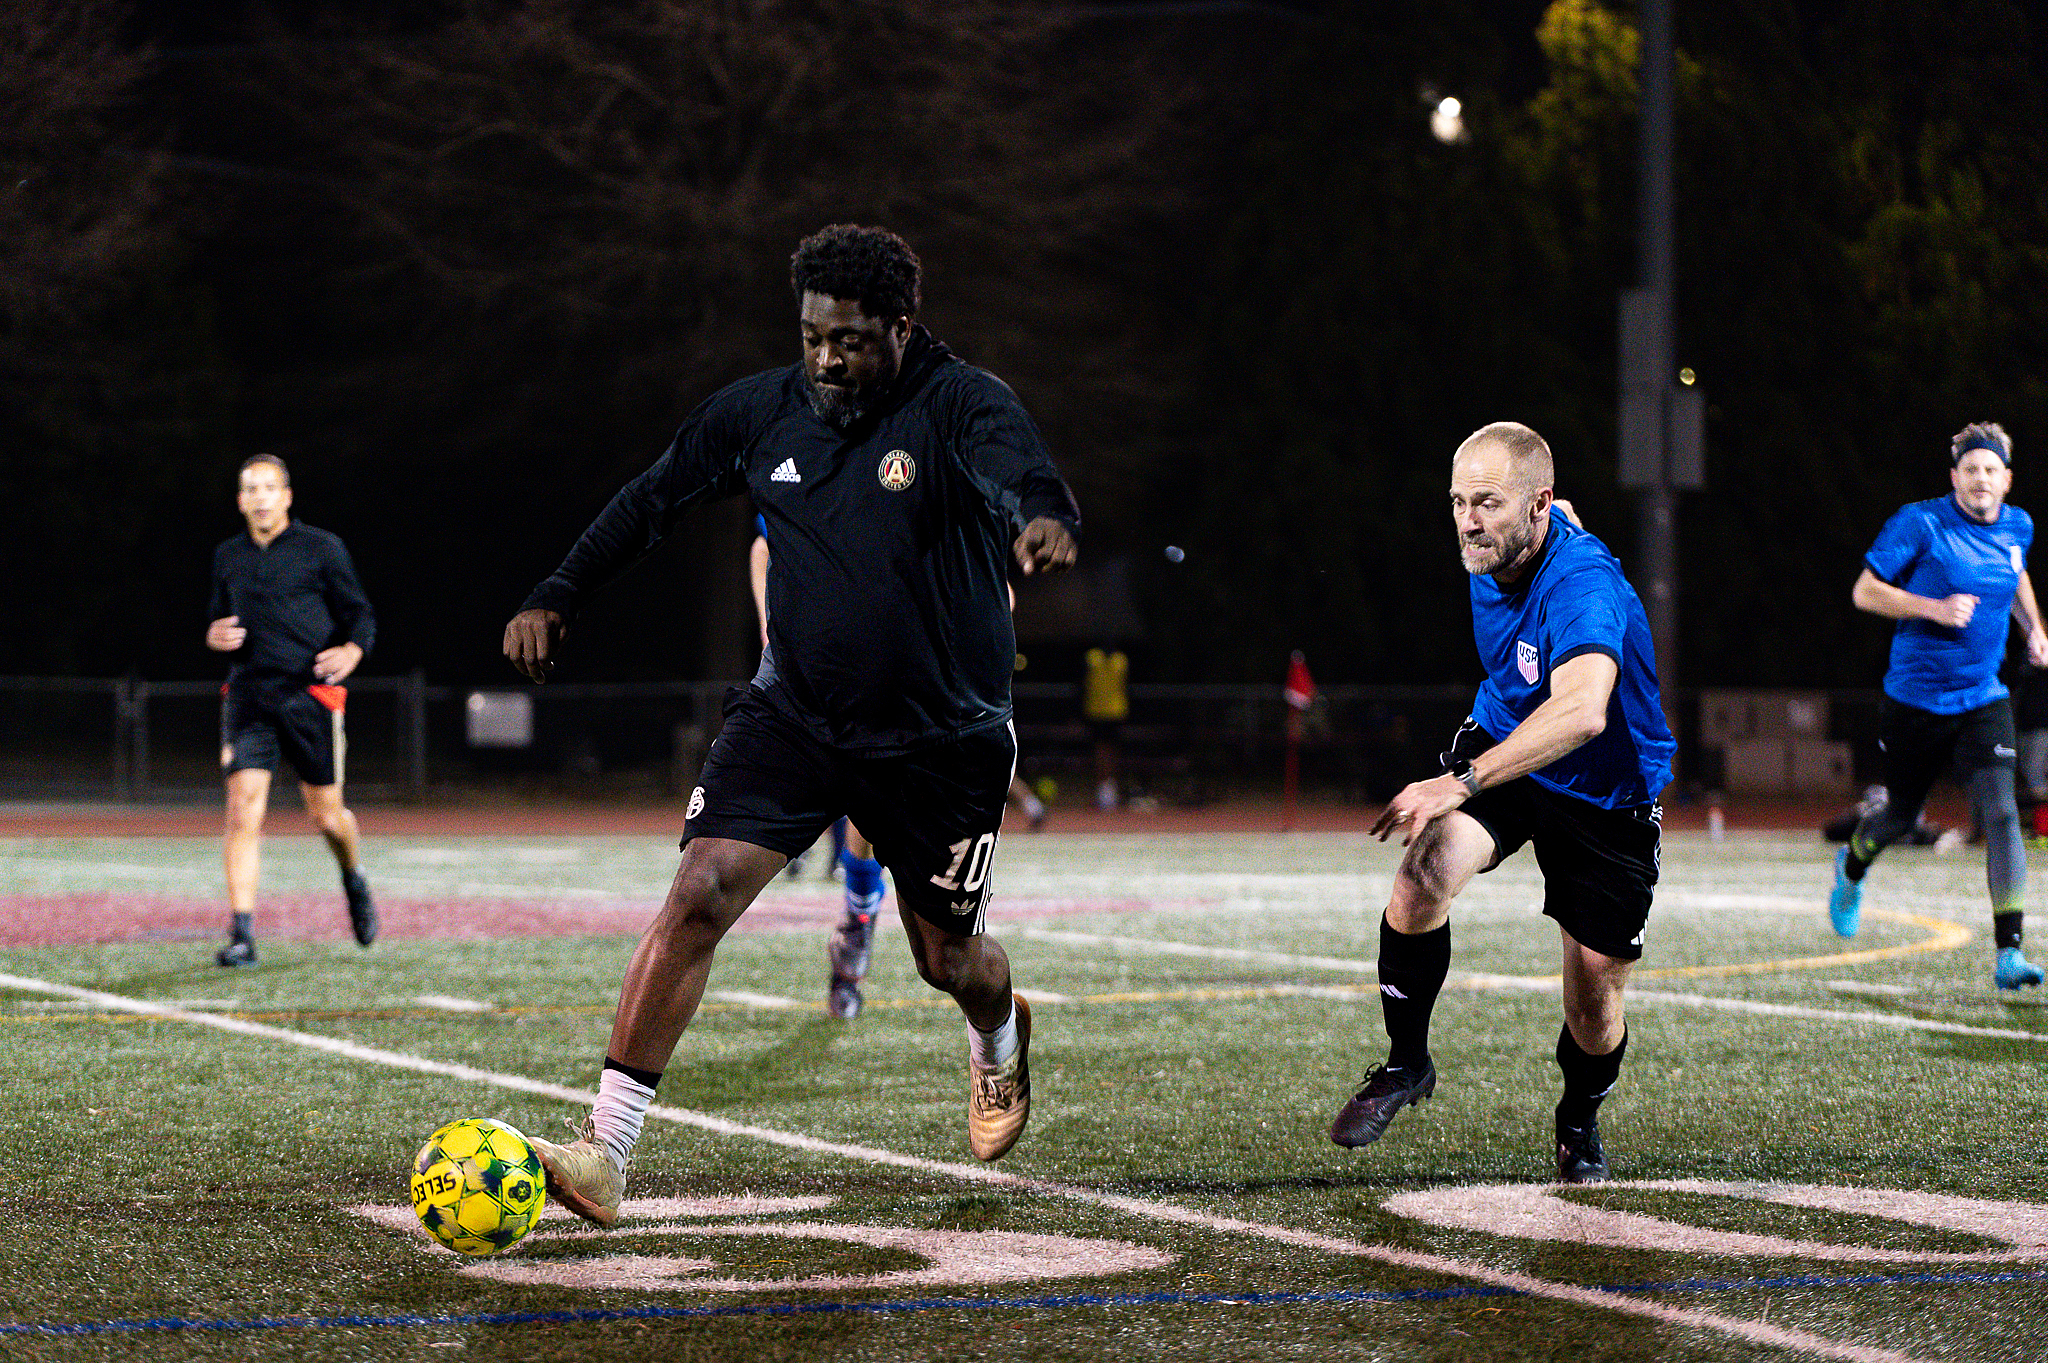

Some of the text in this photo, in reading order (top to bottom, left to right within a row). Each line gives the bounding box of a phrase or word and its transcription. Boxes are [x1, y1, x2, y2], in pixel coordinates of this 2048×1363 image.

[885, 451, 911, 463] ATLANTA
[770, 471, 801, 483] adidas
[1519, 644, 1538, 663] USA
[929, 832, 995, 892] 10
[412, 1171, 457, 1208] SELEC
